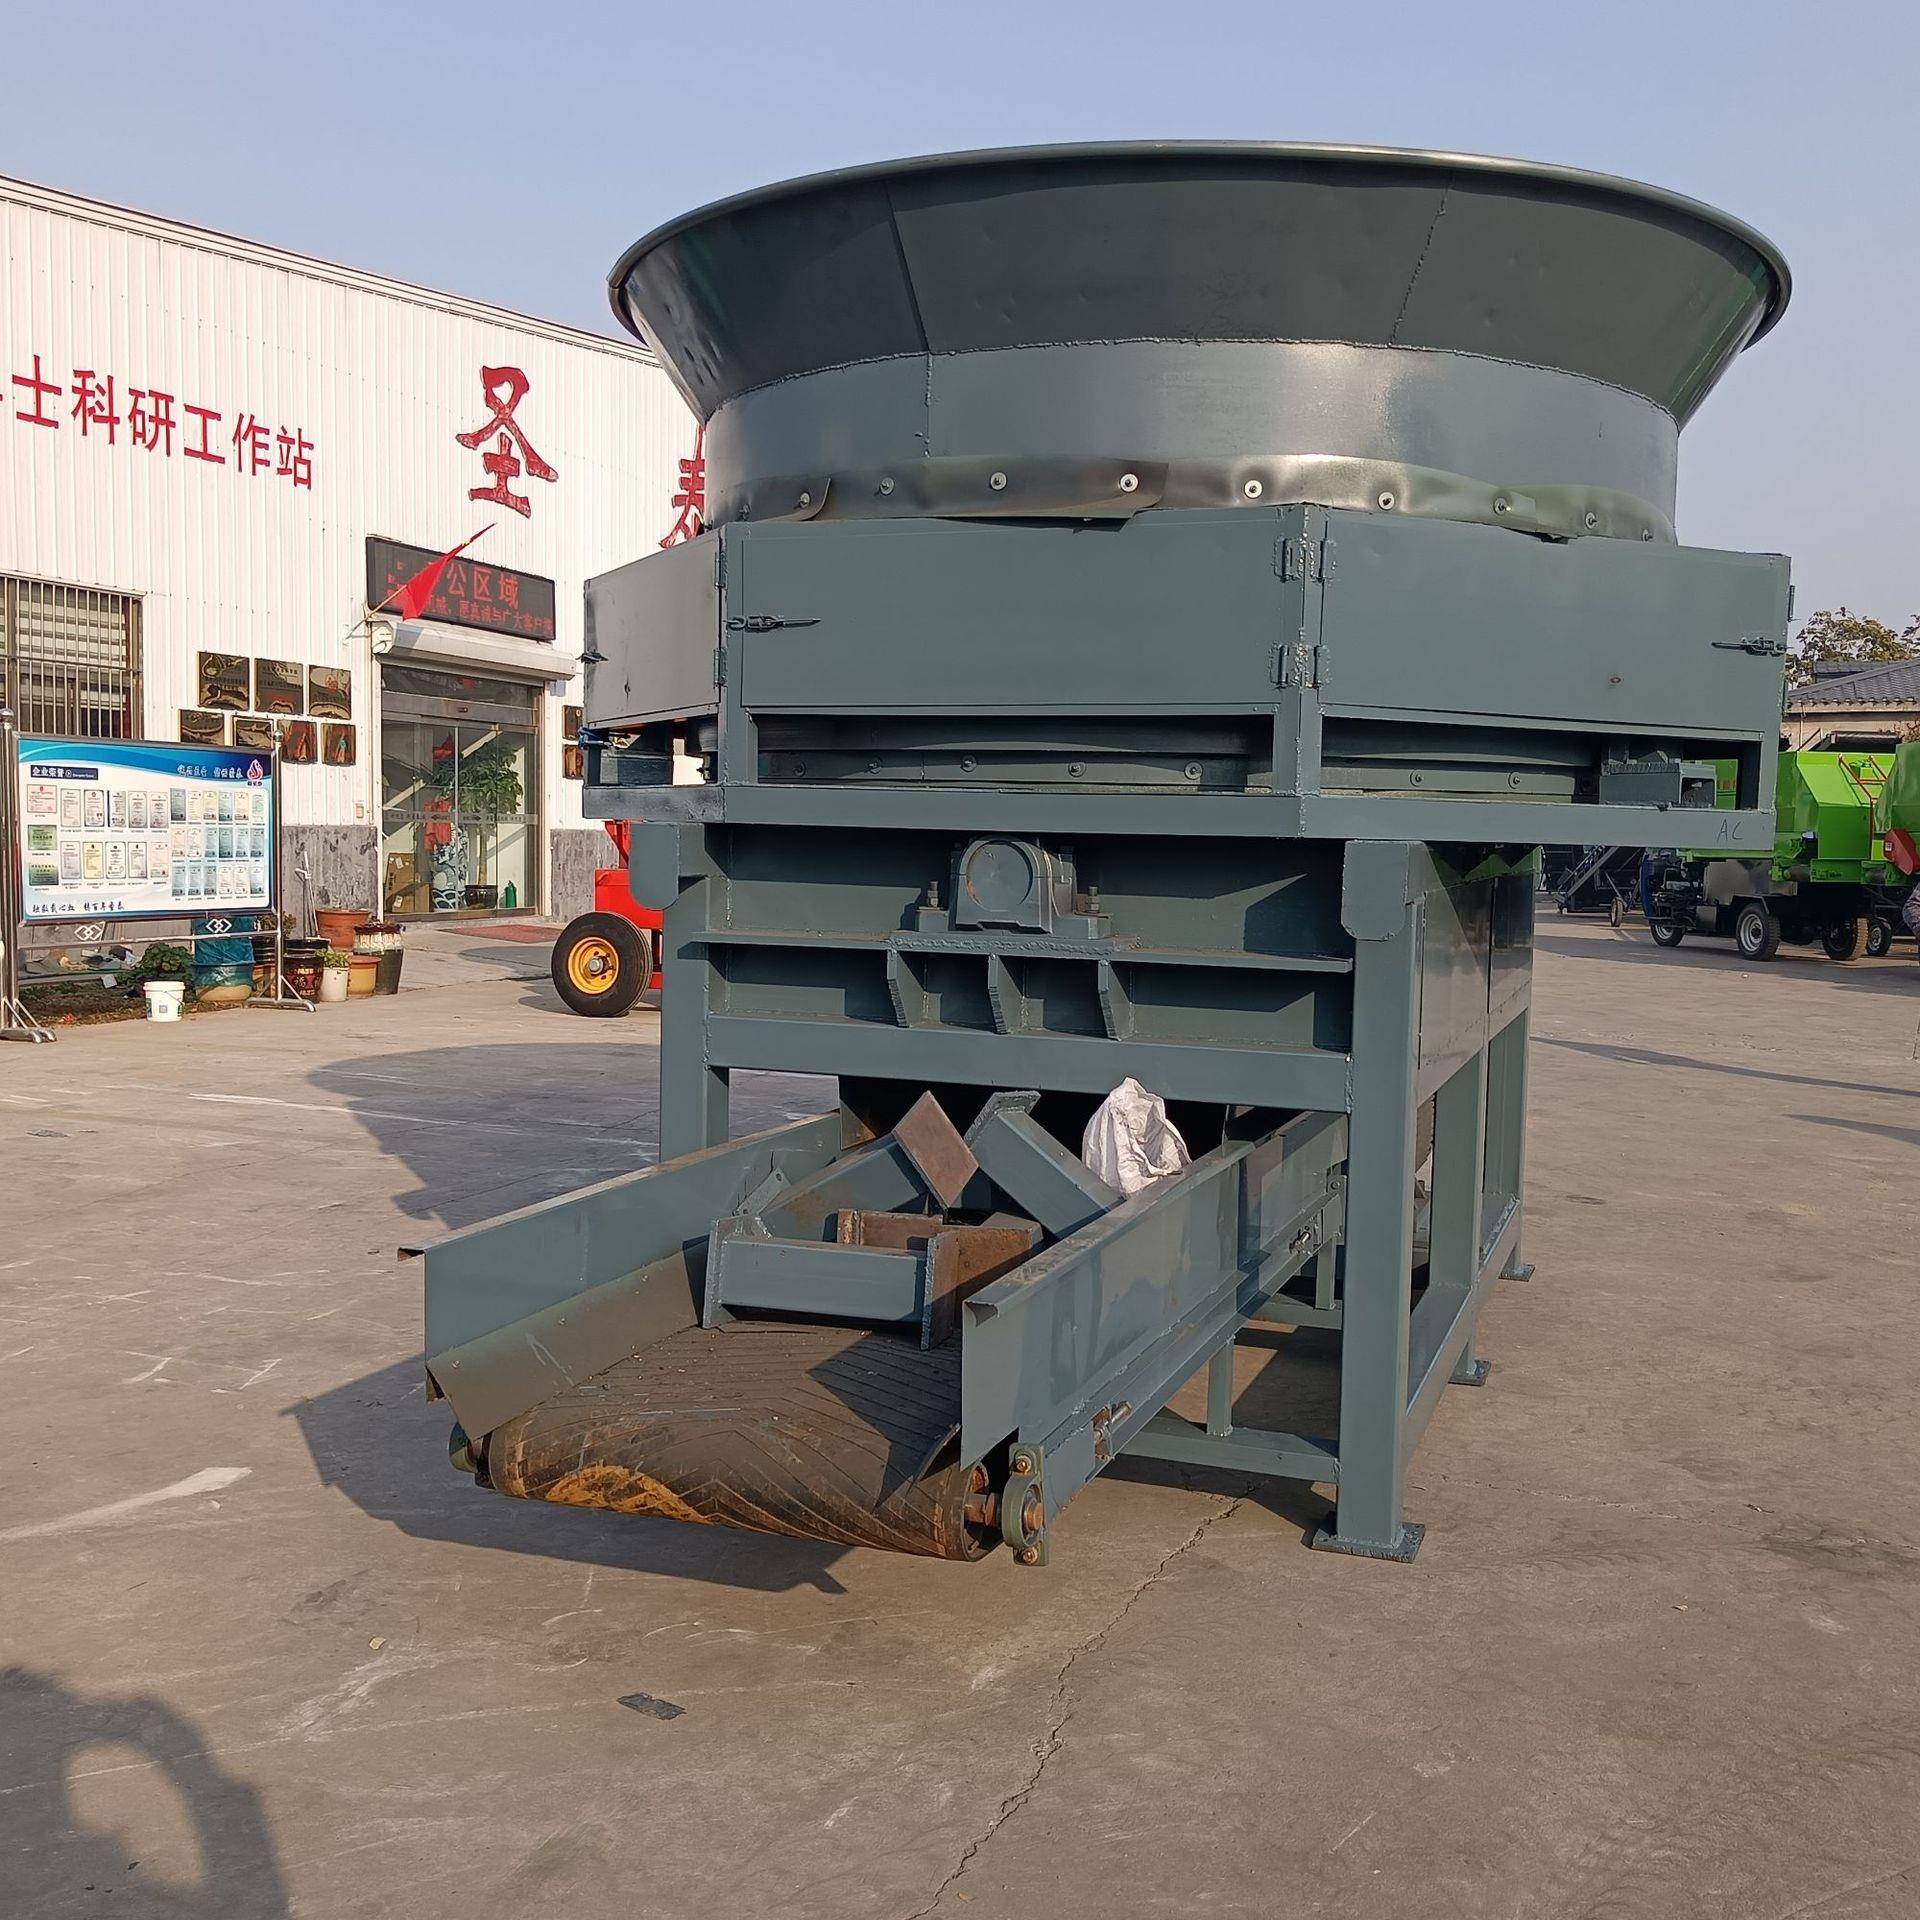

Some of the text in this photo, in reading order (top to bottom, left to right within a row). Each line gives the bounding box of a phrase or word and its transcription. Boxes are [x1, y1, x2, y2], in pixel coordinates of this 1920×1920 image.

[430, 560, 520, 608] 公区域
[1716, 818, 1745, 843] AC
